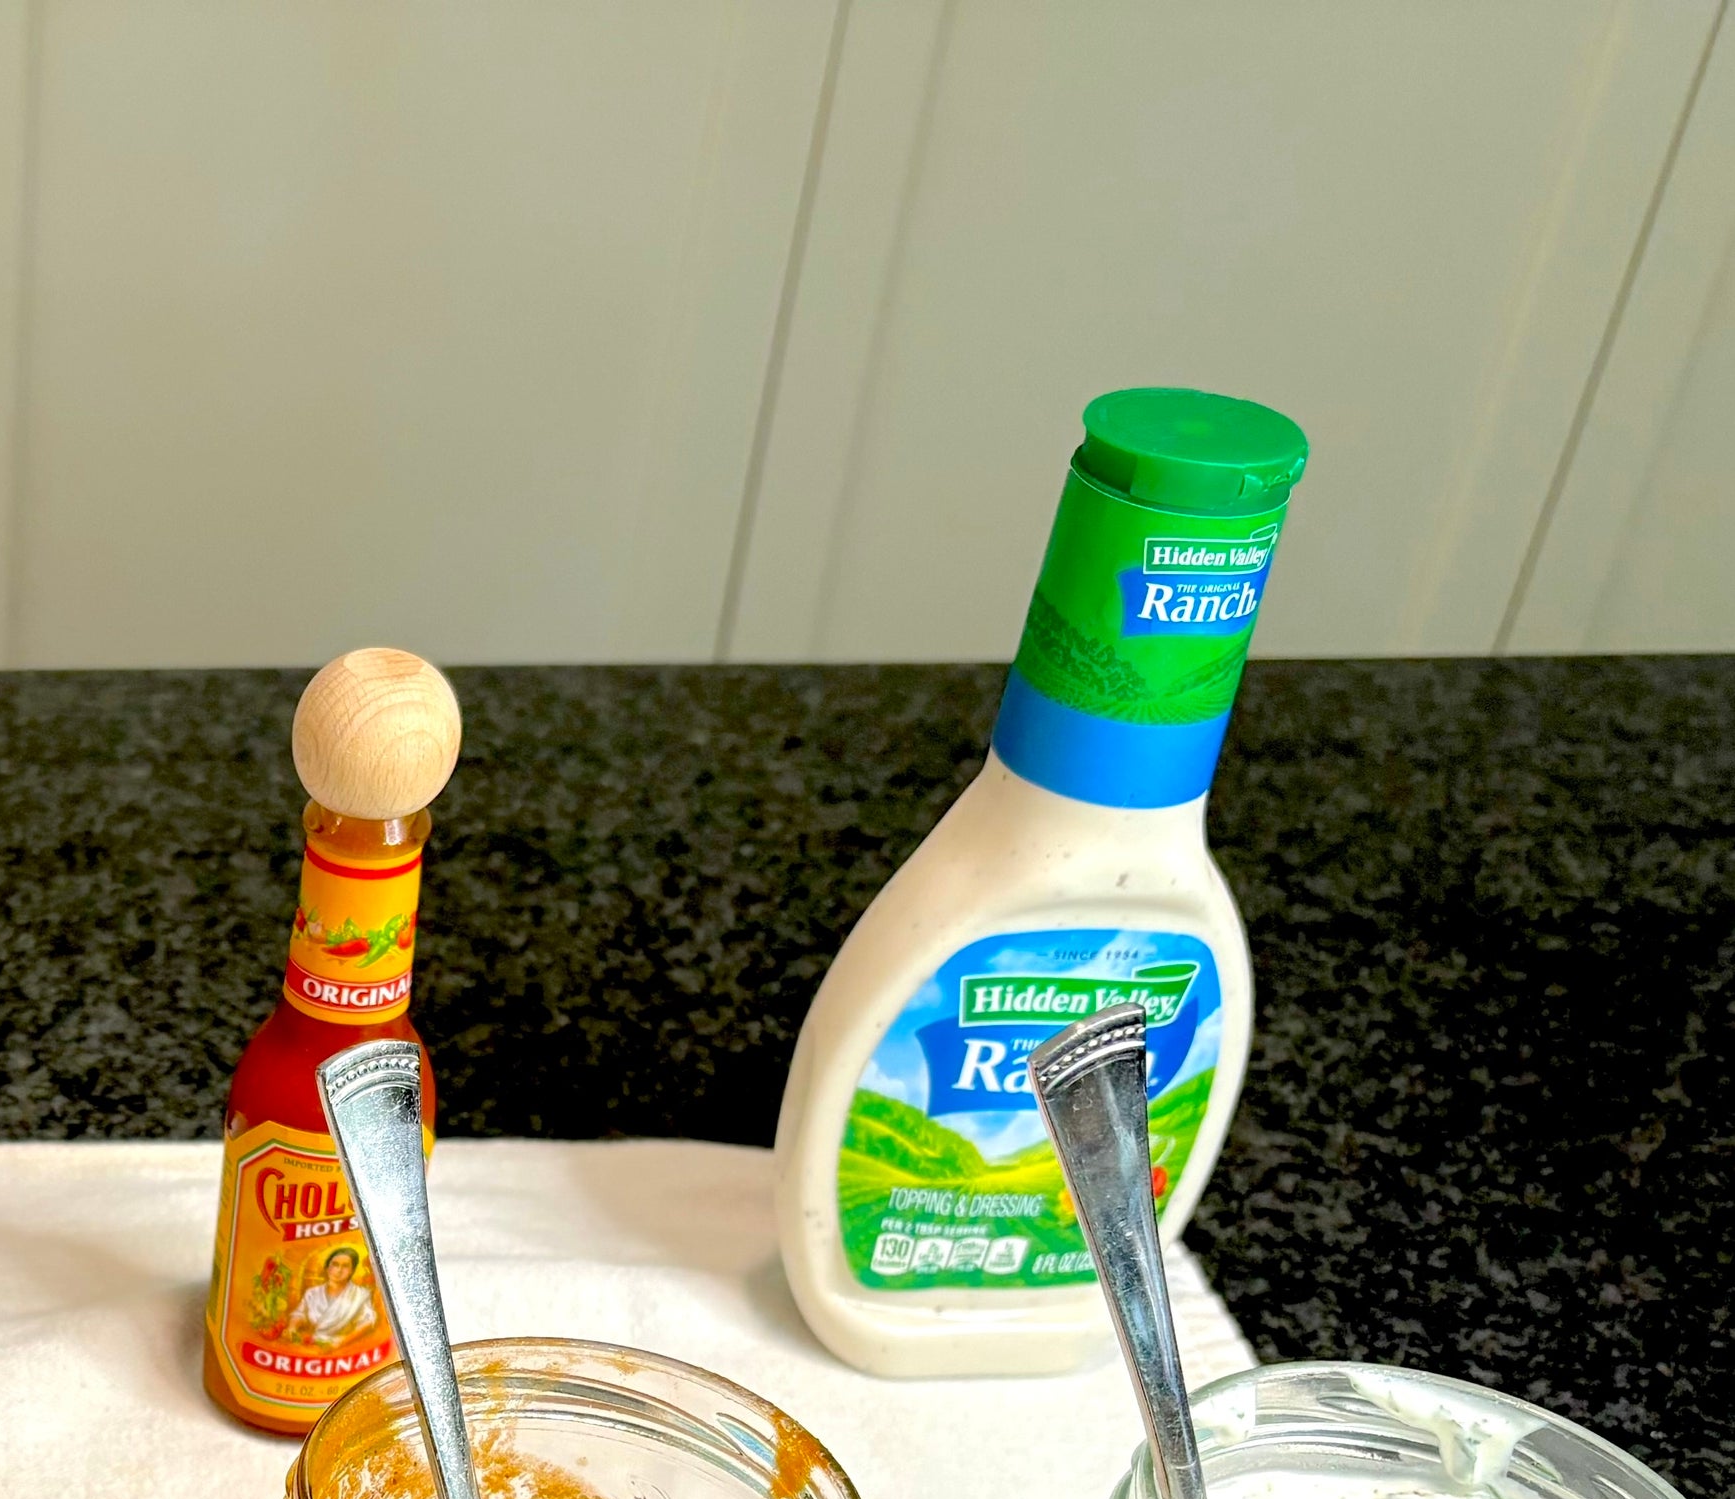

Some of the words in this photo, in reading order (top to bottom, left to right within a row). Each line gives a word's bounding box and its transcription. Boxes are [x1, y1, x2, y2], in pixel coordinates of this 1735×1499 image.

[1151, 546, 1226, 566] Hidden
[1229, 546, 1268, 567] Valley
[1137, 581, 1257, 622] Ranch
[1053, 950, 1098, 960] SINCE
[972, 984, 1089, 1014] Hidden
[283, 1157, 333, 1173] IMPORTED
[255, 1167, 355, 1233] CHOL
[888, 1187, 953, 1216] TOPPING
[954, 1192, 967, 1217] &
[969, 1193, 1045, 1217] DRESSING
[296, 1220, 343, 1239] HOT
[880, 1237, 910, 1257] 130
[253, 1347, 382, 1375] ORIGINAL
[300, 1386, 315, 1397] OZ
